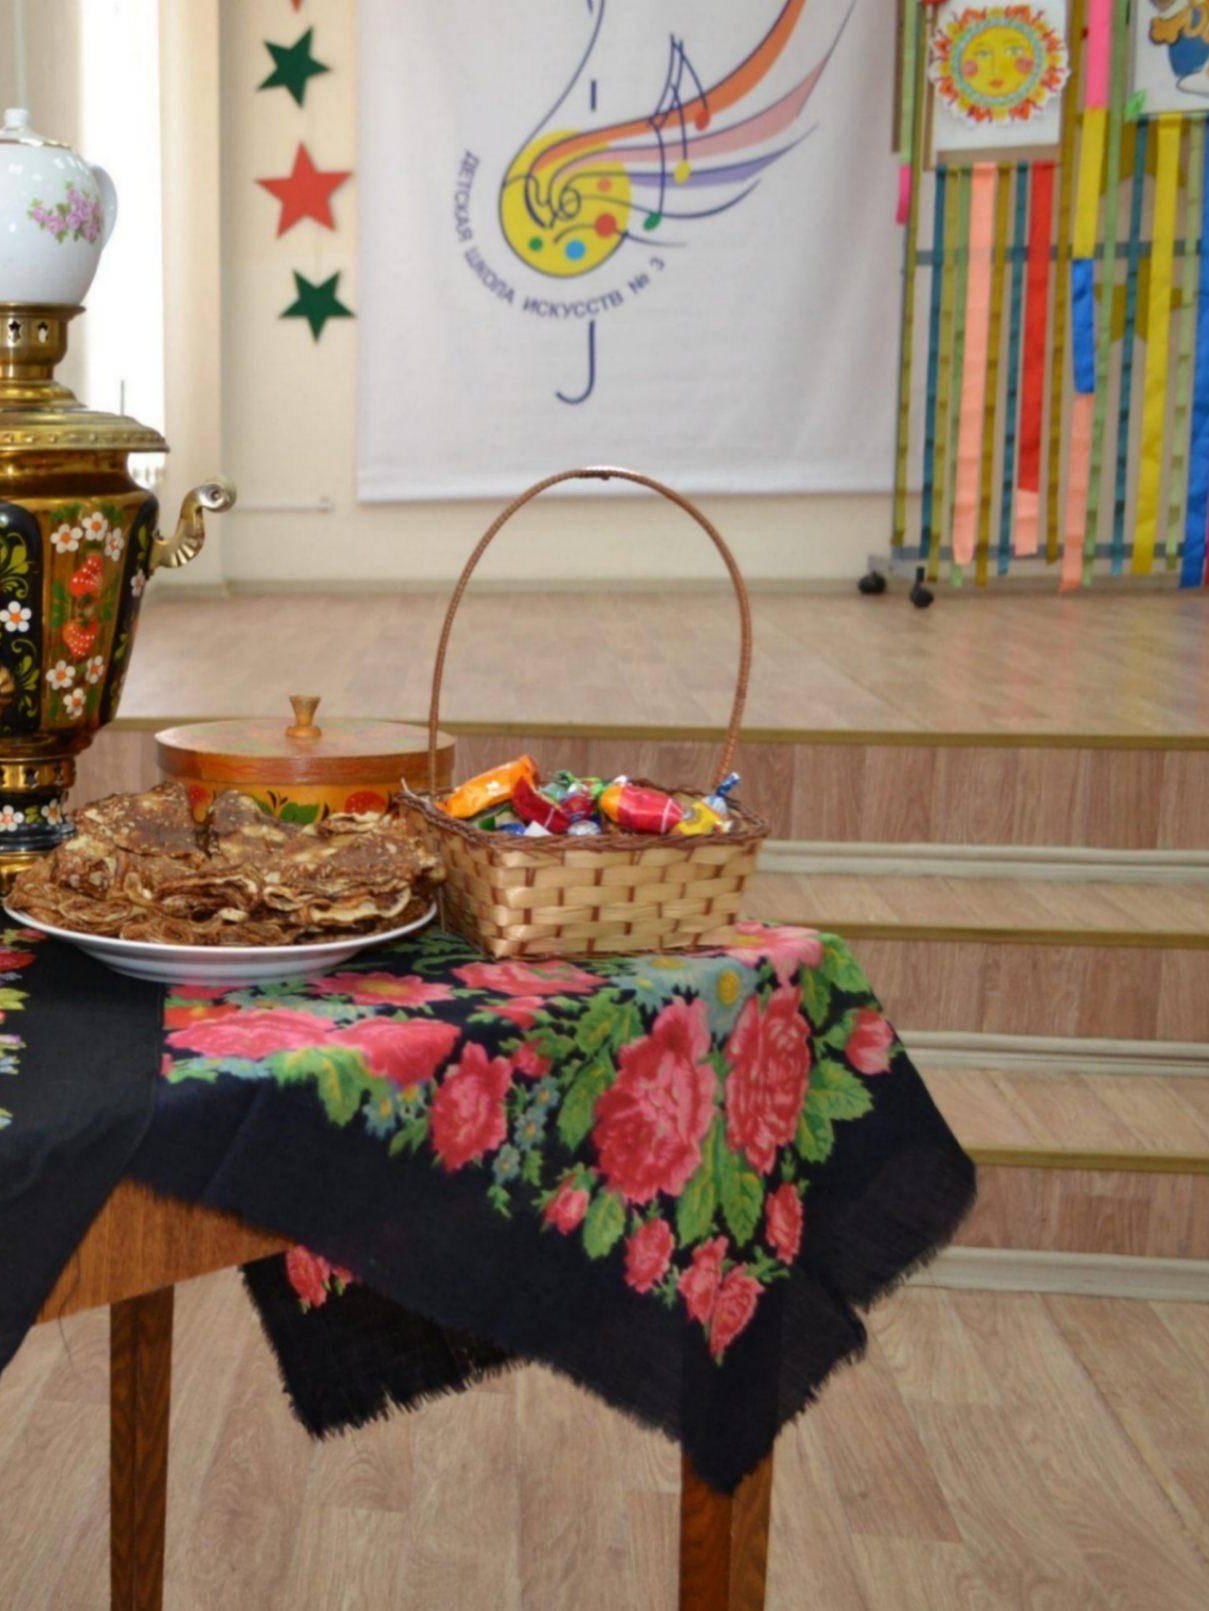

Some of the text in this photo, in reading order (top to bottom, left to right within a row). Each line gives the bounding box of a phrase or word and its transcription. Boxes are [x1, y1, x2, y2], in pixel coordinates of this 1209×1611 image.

[454, 150, 480, 242] ДЕТСКАЯ
[464, 247, 516, 304] ШКОЛА
[649, 256, 665, 271] 3
[522, 290, 625, 319] ИСКУССТВ
